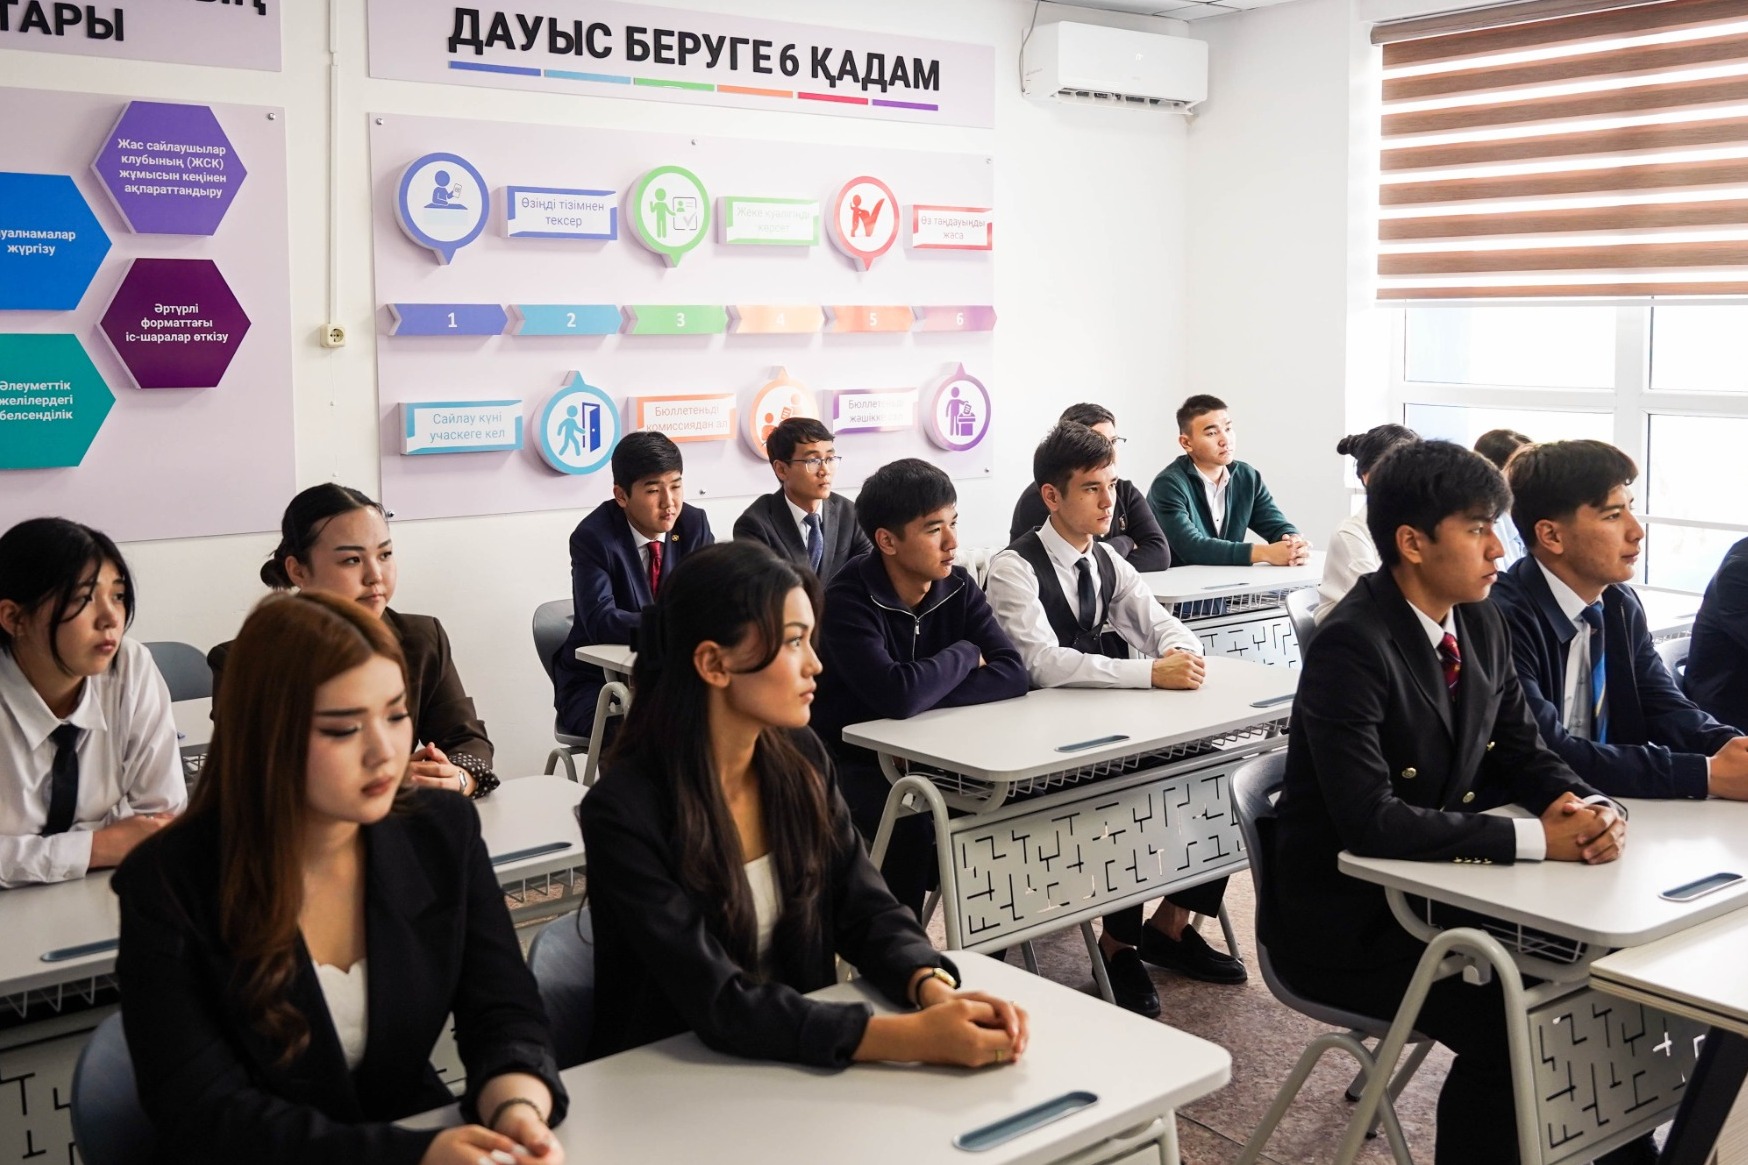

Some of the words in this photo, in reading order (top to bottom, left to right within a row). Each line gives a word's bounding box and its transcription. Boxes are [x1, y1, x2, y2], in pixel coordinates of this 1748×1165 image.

[448, 7, 613, 59] ДАУЫС
[626, 26, 773, 75] БЕРУГЕ
[779, 43, 800, 77] 6
[811, 45, 940, 93] ҚАДАМ
[117, 138, 144, 150] Жас
[146, 140, 226, 157] сайлаушылар
[121, 154, 184, 168] клубының
[186, 157, 224, 171] (ЖСК)
[119, 169, 180, 181] жұмысын
[182, 174, 227, 184] кеңінен
[124, 184, 223, 199] ақпараттандыру
[521, 197, 556, 211] Өзіңді
[559, 200, 605, 212] тізімнен
[545, 216, 583, 228] тексер
[0, 228, 77, 243] уалнамалар
[7, 243, 56, 257] жүргізу
[154, 303, 199, 316] Әртүрлі
[140, 317, 213, 330] форматтағы
[447, 312, 458, 328] 1
[566, 312, 577, 328] 2
[676, 312, 686, 328] 3
[869, 313, 878, 327] 5
[956, 312, 965, 327] 6
[125, 331, 191, 344] іс-шаралар
[193, 331, 229, 344] өткізу
[0, 380, 71, 393] Әлеуметтік
[0, 394, 73, 408] желілердегі
[0, 409, 73, 422] белсенділік
[433, 413, 477, 426] Сайлау
[479, 411, 502, 425] күні
[646, 420, 713, 432] комиссиядан
[429, 429, 482, 444] учаскеге
[485, 429, 505, 439] кел
